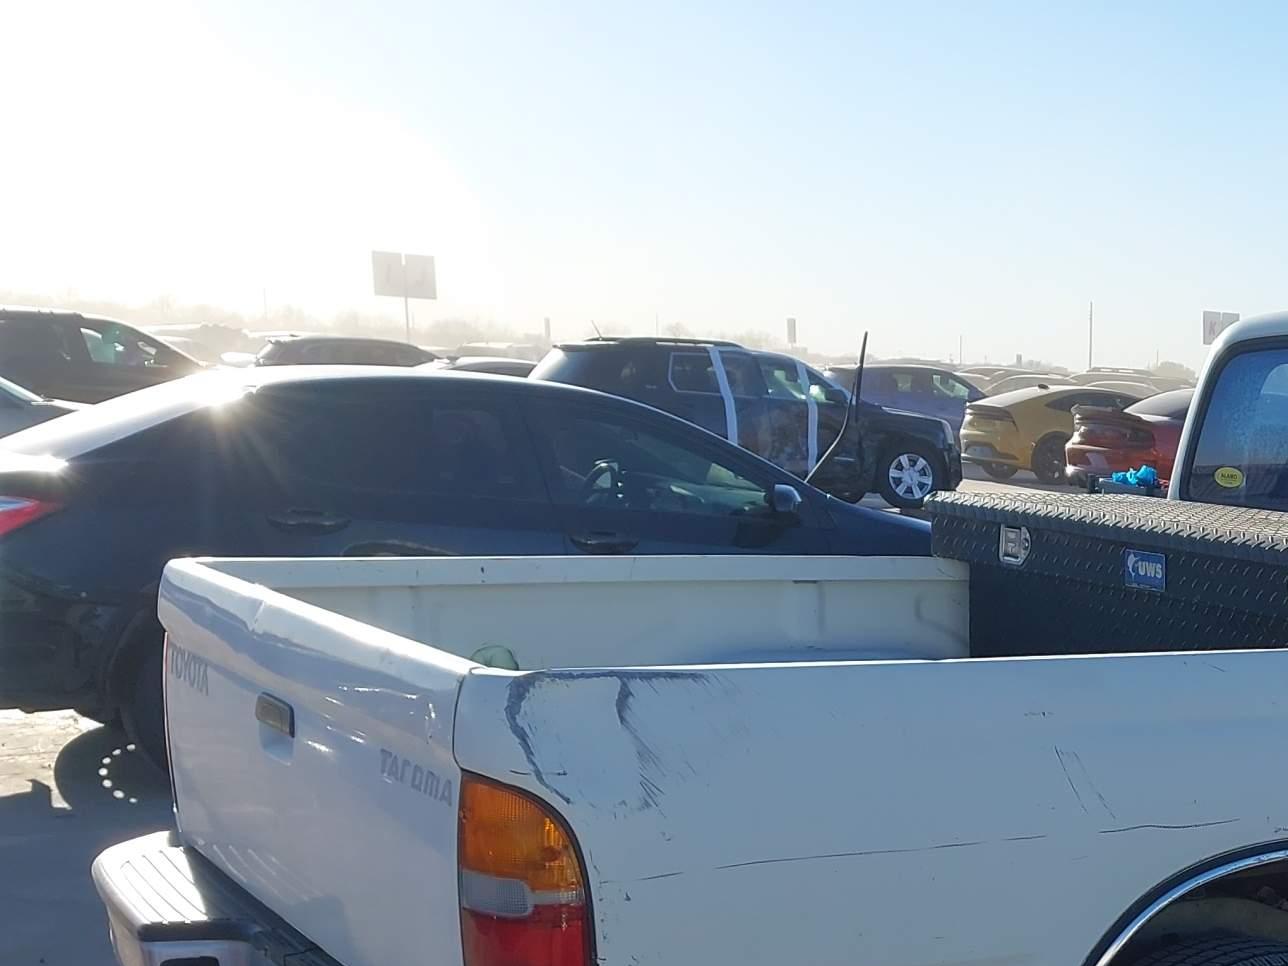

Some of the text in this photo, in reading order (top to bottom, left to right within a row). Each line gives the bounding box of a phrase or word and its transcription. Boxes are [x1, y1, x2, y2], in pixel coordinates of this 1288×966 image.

[1137, 560, 1163, 580] UWS
[170, 647, 209, 696] TOYOTA
[380, 748, 453, 807] TACOMA
